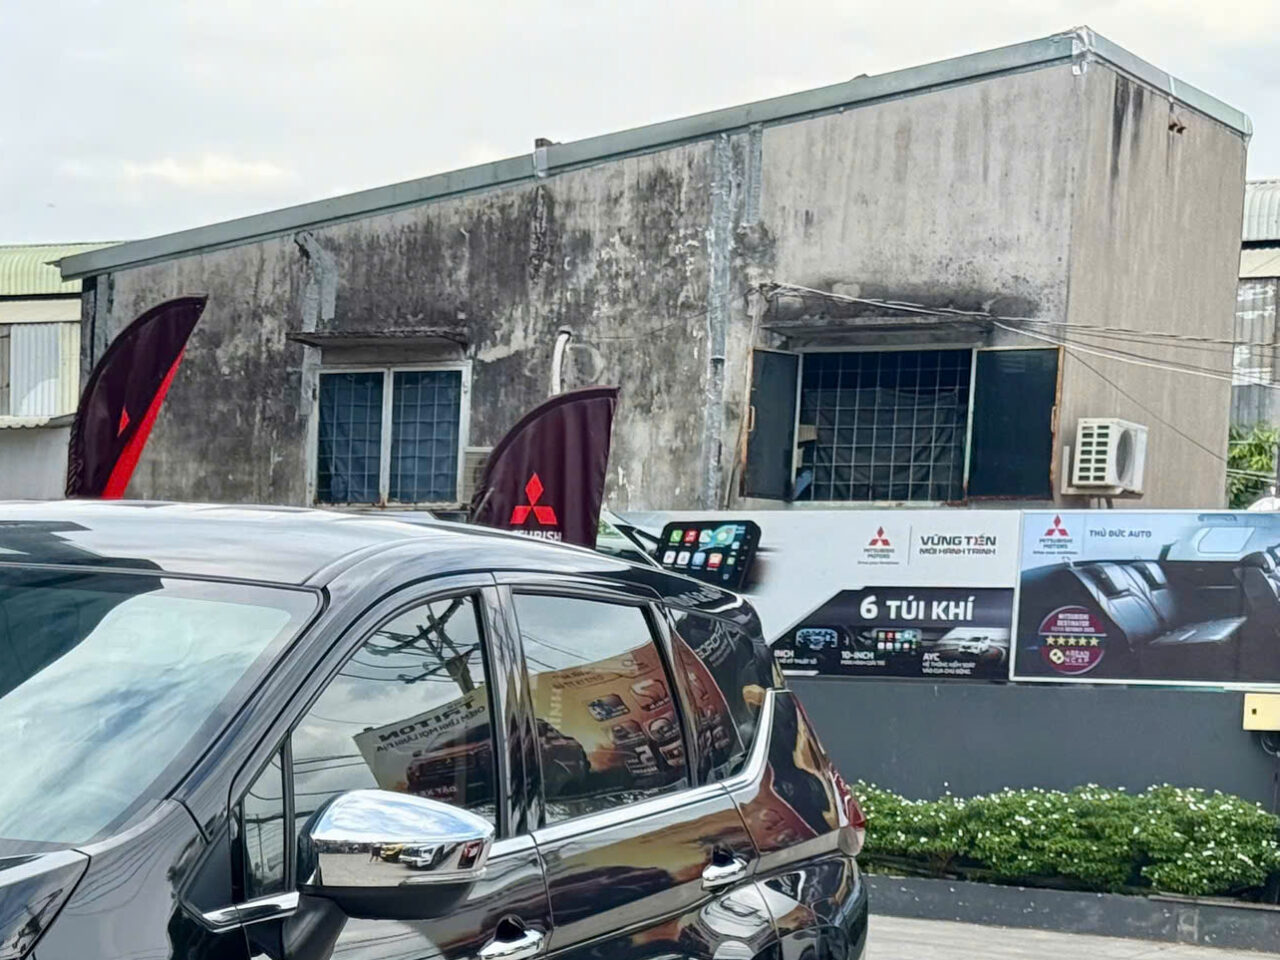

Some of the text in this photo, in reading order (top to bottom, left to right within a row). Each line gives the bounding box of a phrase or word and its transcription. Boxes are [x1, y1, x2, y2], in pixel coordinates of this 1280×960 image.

[920, 533, 962, 546] VỮNG
[1127, 530, 1152, 538] AUTO
[860, 594, 976, 621] 6 TÚI KHÍ
[922, 651, 941, 662] AYC
